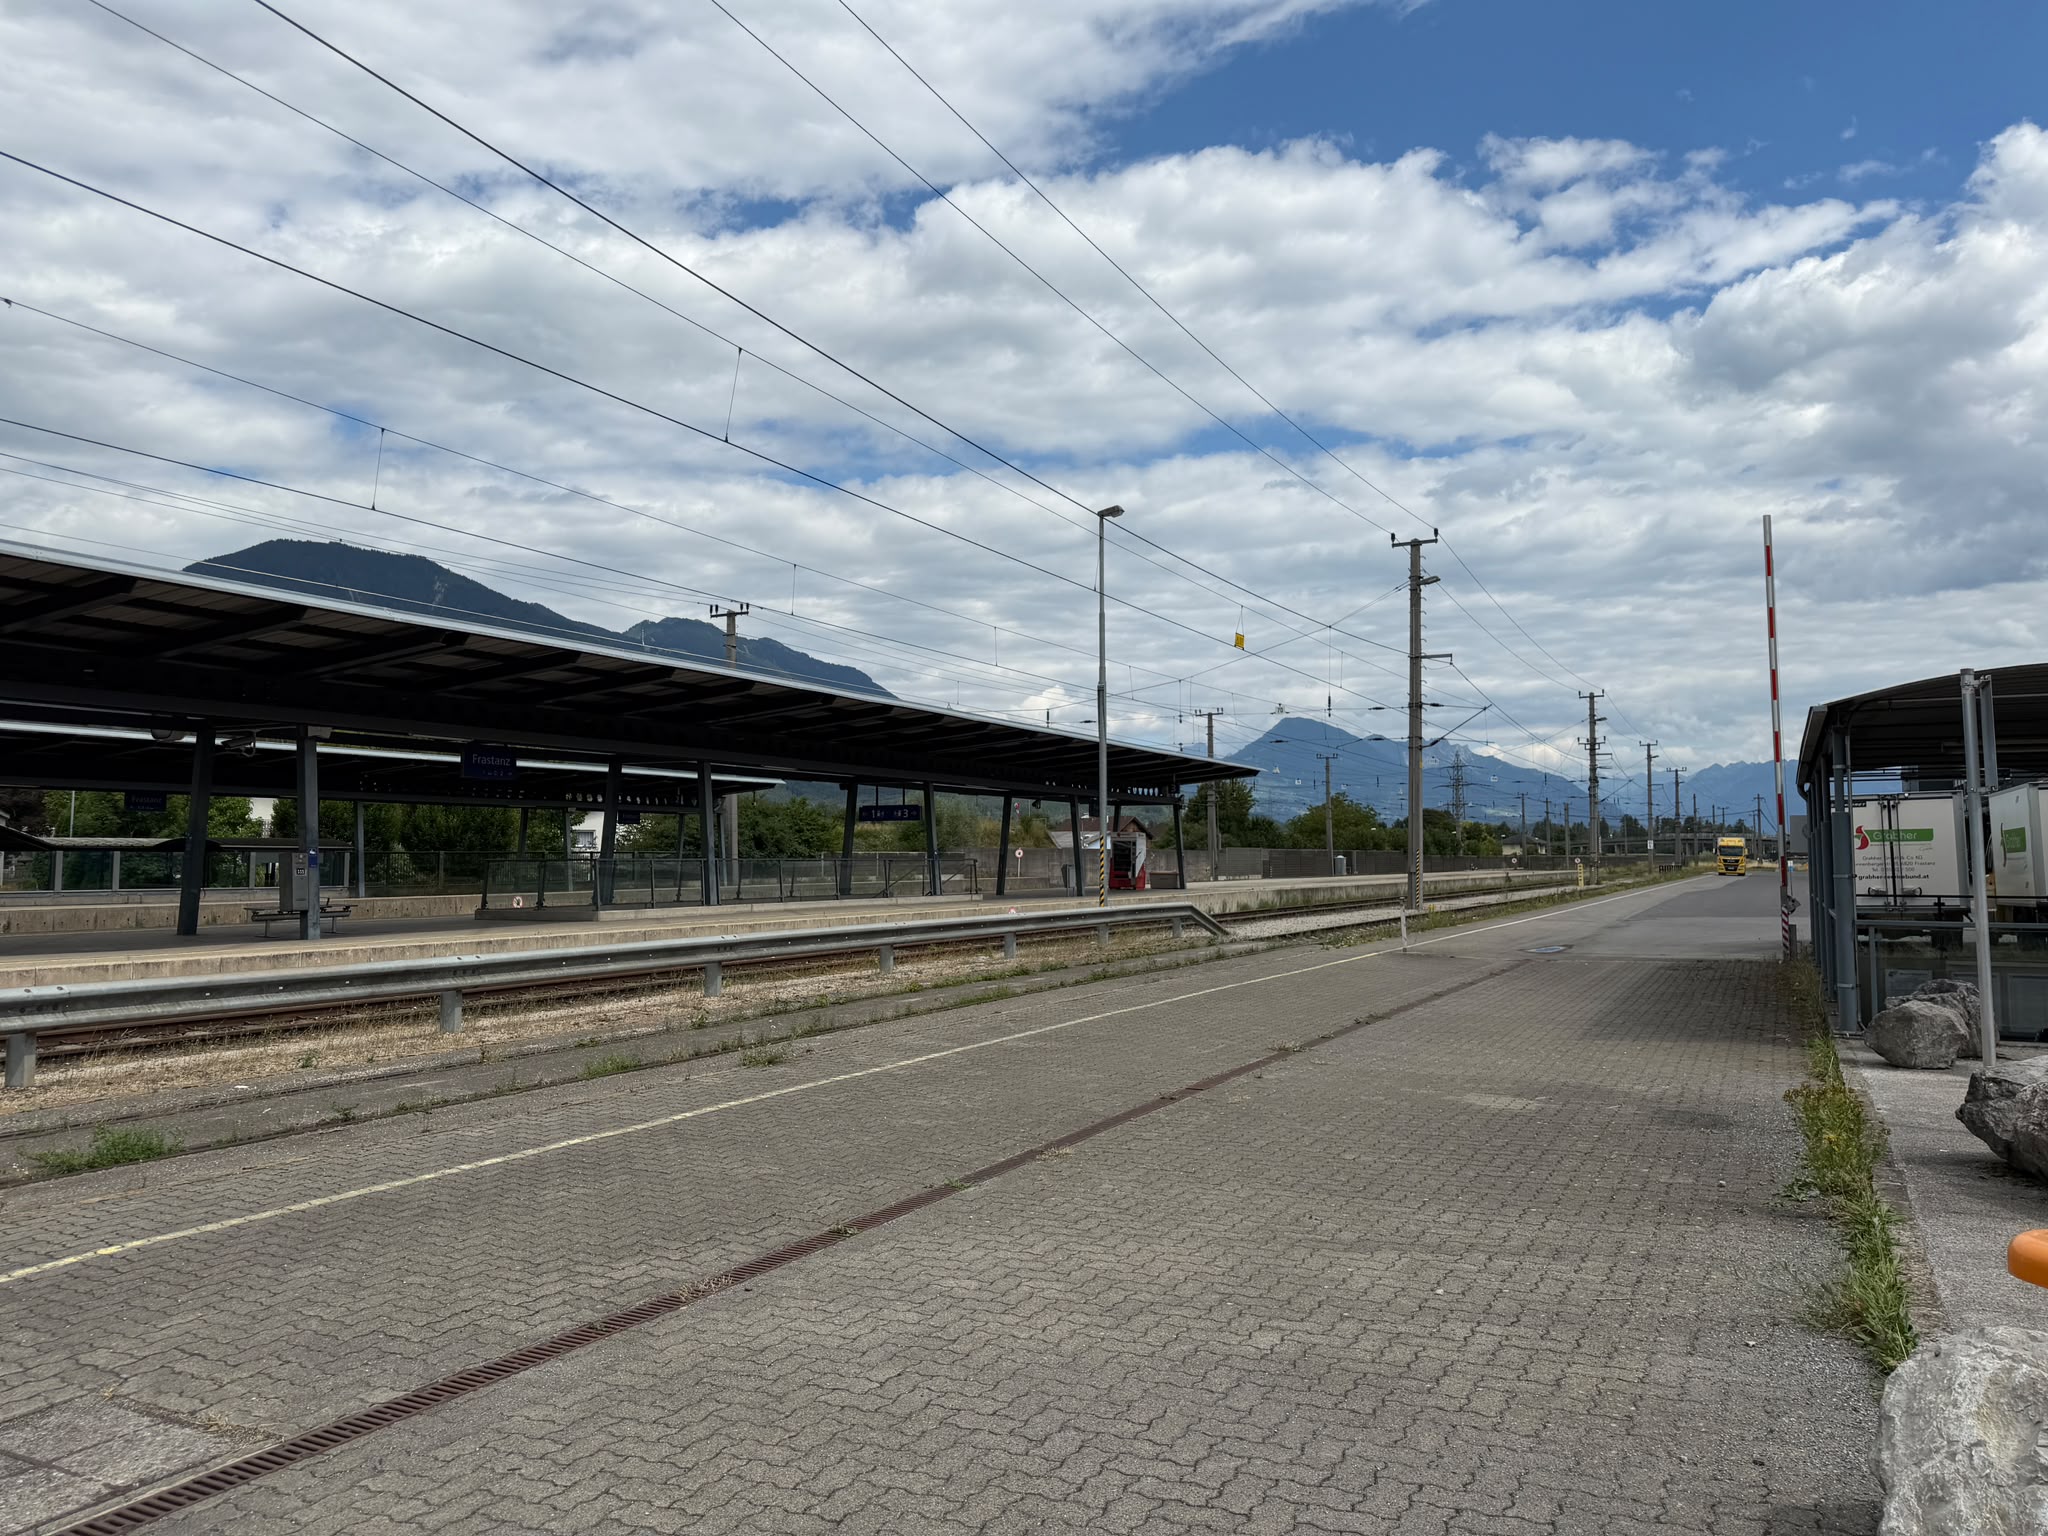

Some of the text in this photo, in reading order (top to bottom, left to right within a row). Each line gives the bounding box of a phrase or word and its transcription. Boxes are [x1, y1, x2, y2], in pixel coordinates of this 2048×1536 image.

[472, 753, 511, 766] Frastanz
[902, 808, 909, 819] 3
[1872, 831, 1918, 841] Grabher
